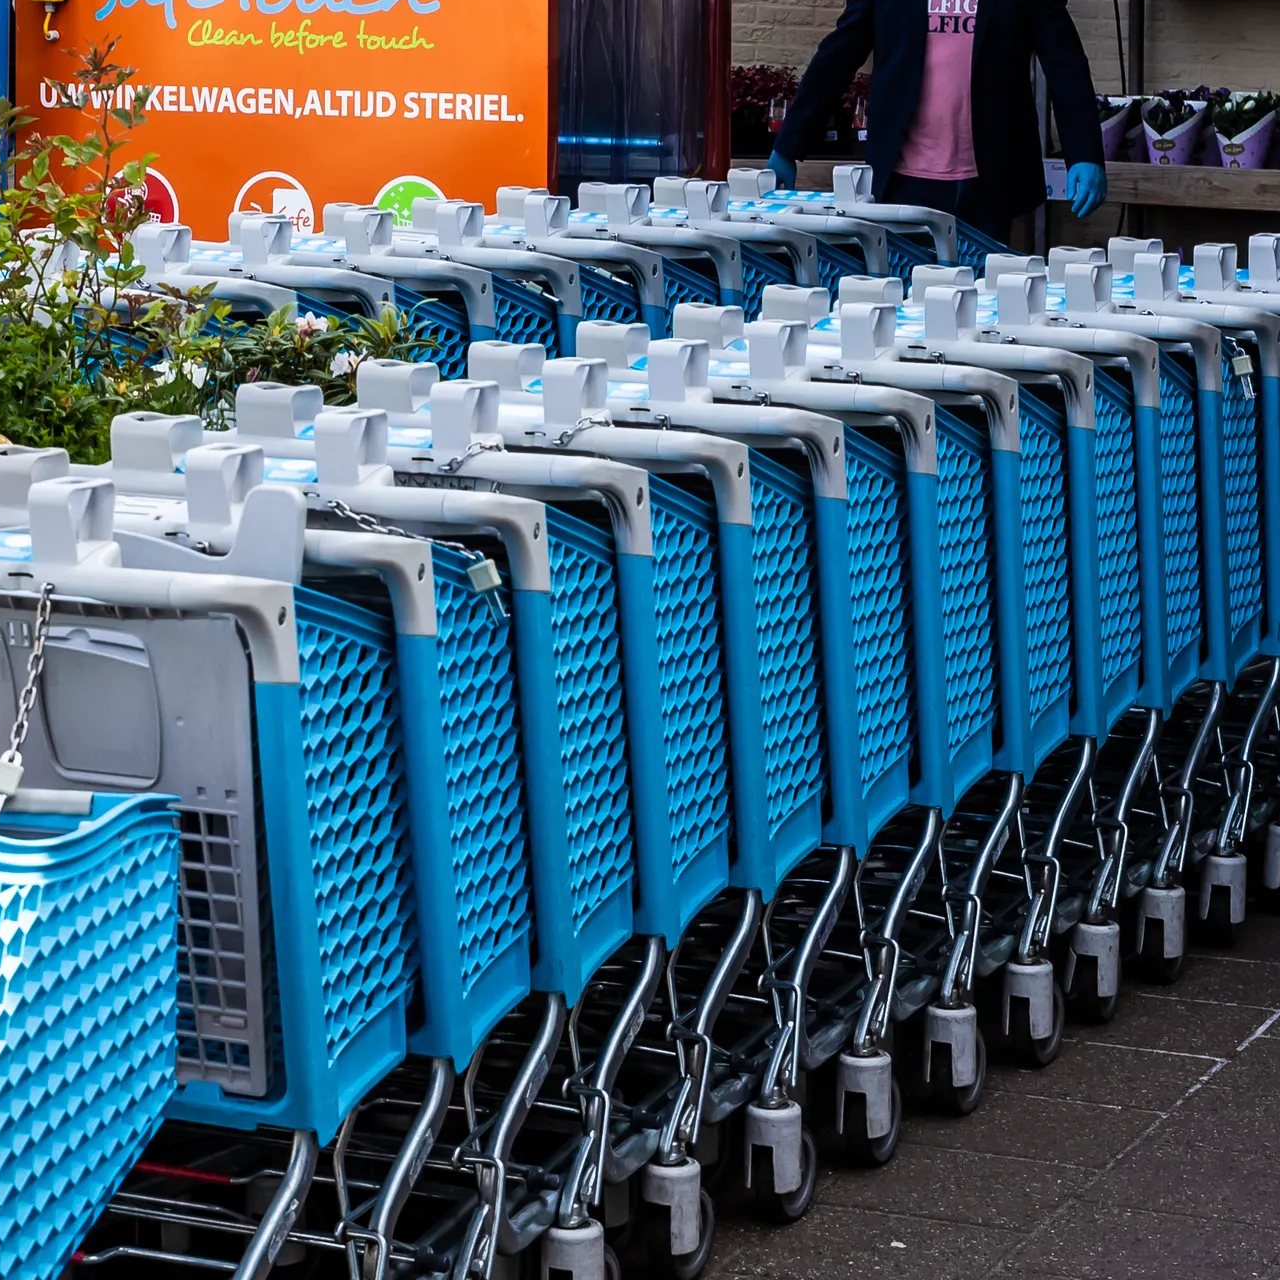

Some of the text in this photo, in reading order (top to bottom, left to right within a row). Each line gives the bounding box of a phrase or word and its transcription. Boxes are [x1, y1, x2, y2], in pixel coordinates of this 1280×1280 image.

[186, 19, 435, 55] Clean before touch
[403, 90, 524, 122] STERIEL.
